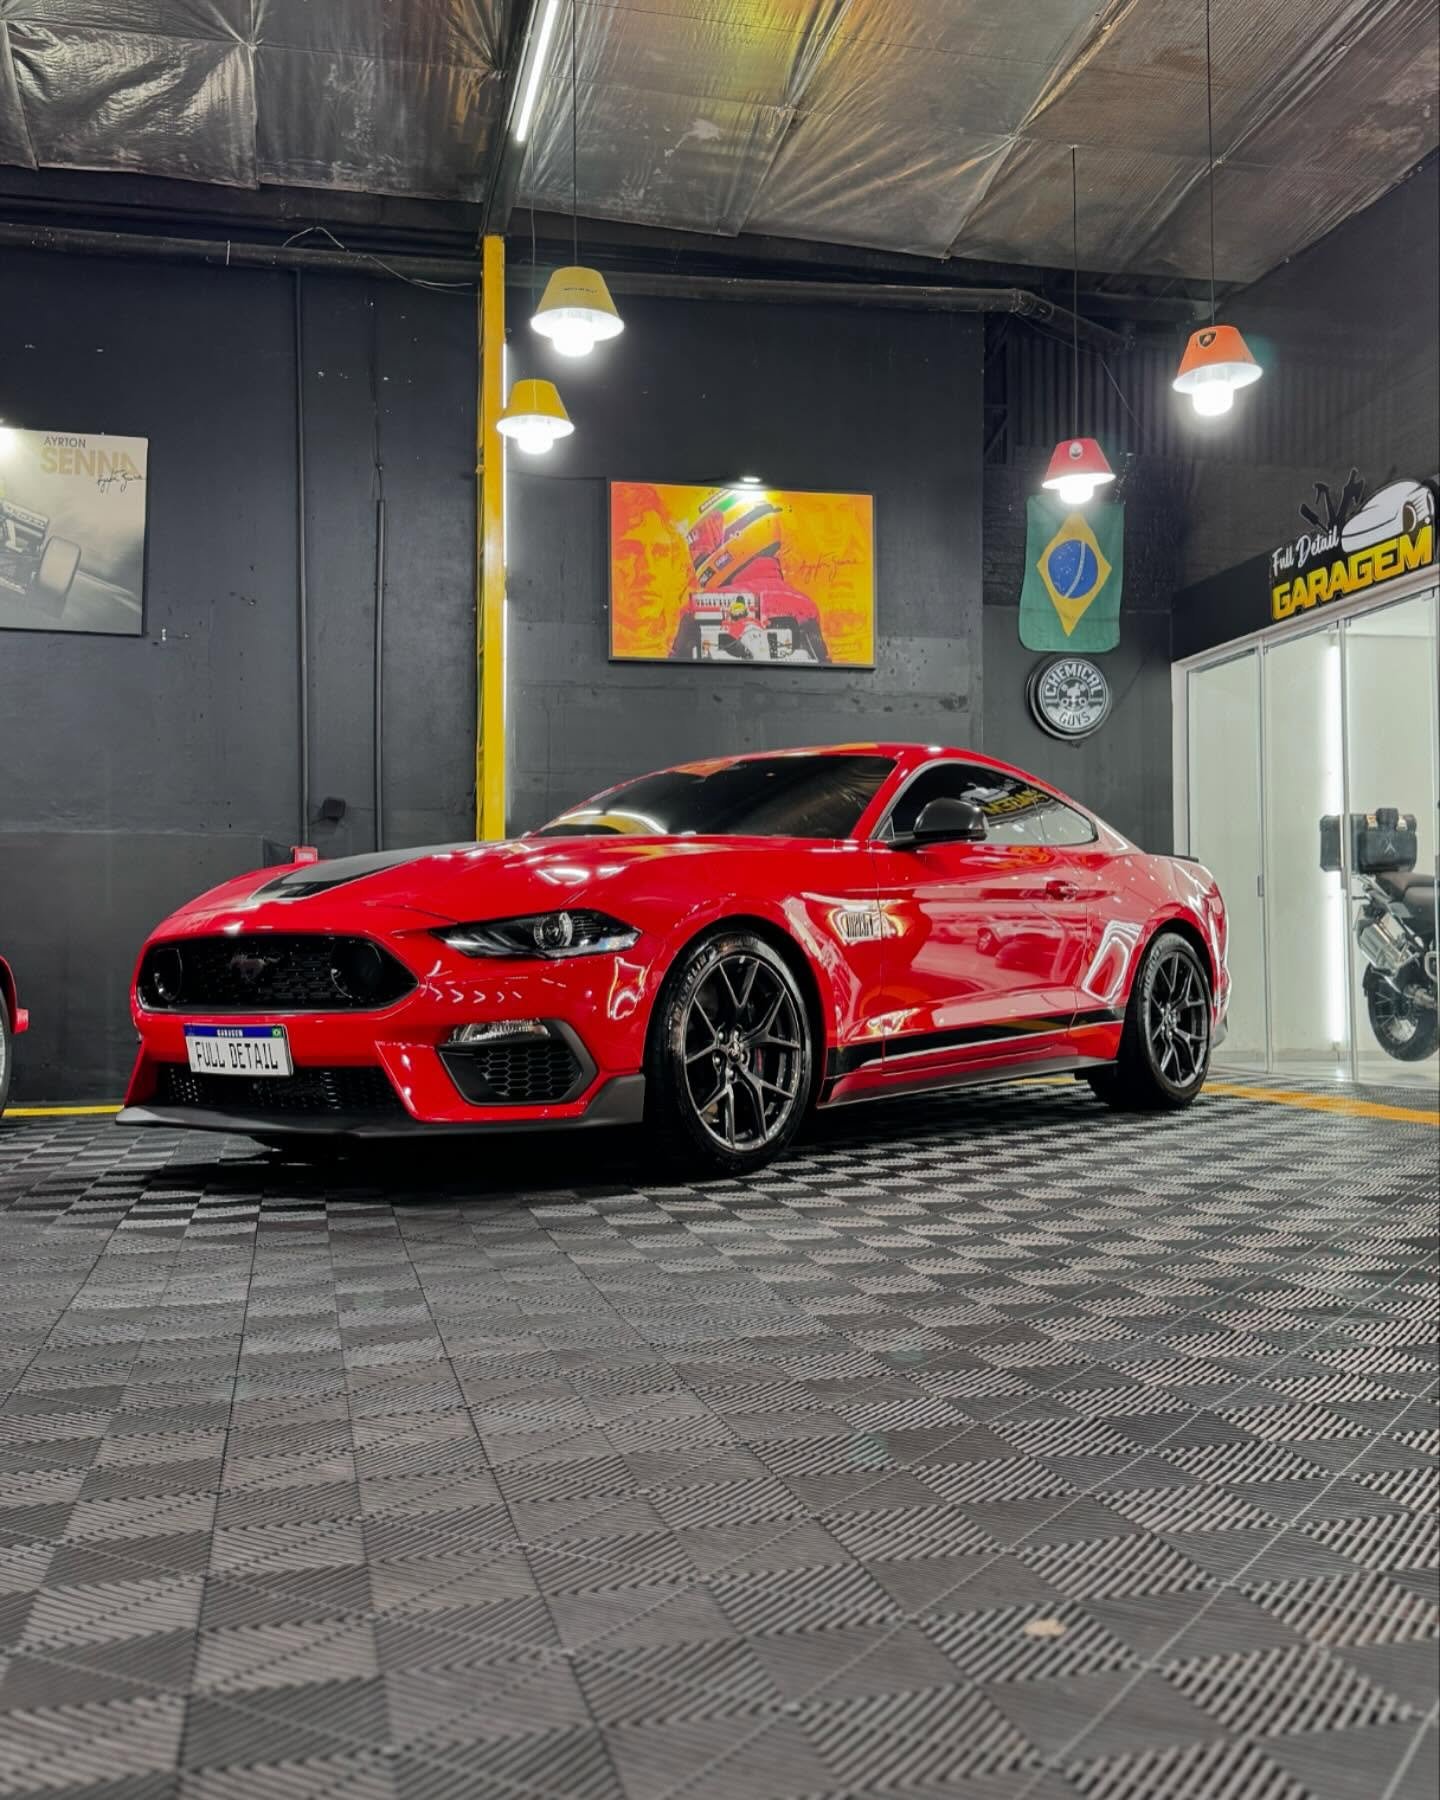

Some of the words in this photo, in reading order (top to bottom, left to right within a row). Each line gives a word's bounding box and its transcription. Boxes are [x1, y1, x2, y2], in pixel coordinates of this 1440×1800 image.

[43, 437, 86, 448] AYRTON
[41, 448, 139, 476] SENNA
[1272, 546, 1294, 576] Full
[1296, 525, 1339, 568] Detail
[1272, 525, 1433, 620] GARAGEM
[1045, 663, 1102, 696] CHEMICAL
[1060, 711, 1091, 726] GUYS
[195, 1042, 225, 1068] FULL
[229, 1043, 278, 1069] DETAIL
